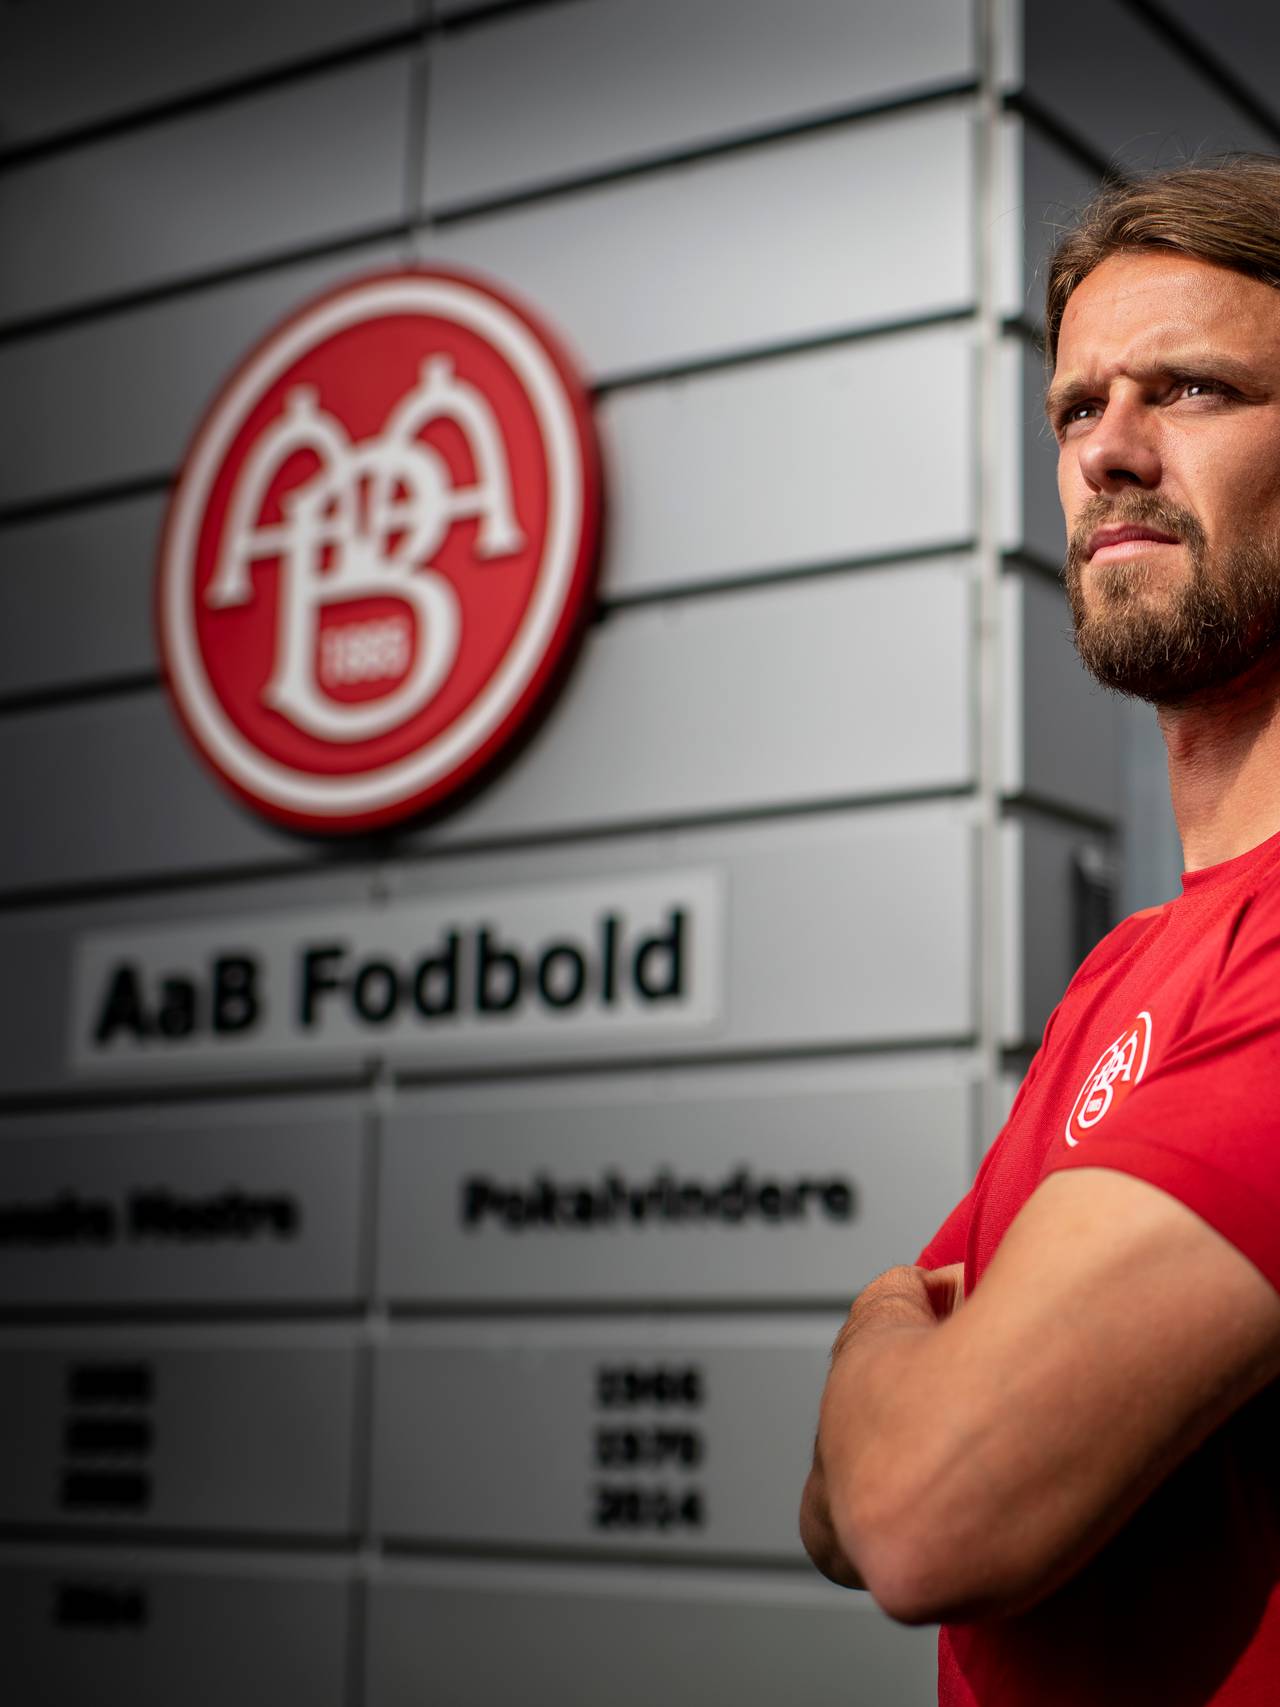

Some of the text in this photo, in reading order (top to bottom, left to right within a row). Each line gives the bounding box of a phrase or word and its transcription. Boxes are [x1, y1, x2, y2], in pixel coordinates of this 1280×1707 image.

[95, 905, 686, 1046] AaB Fodbold
[463, 1168, 857, 1230] Pokalvindere
